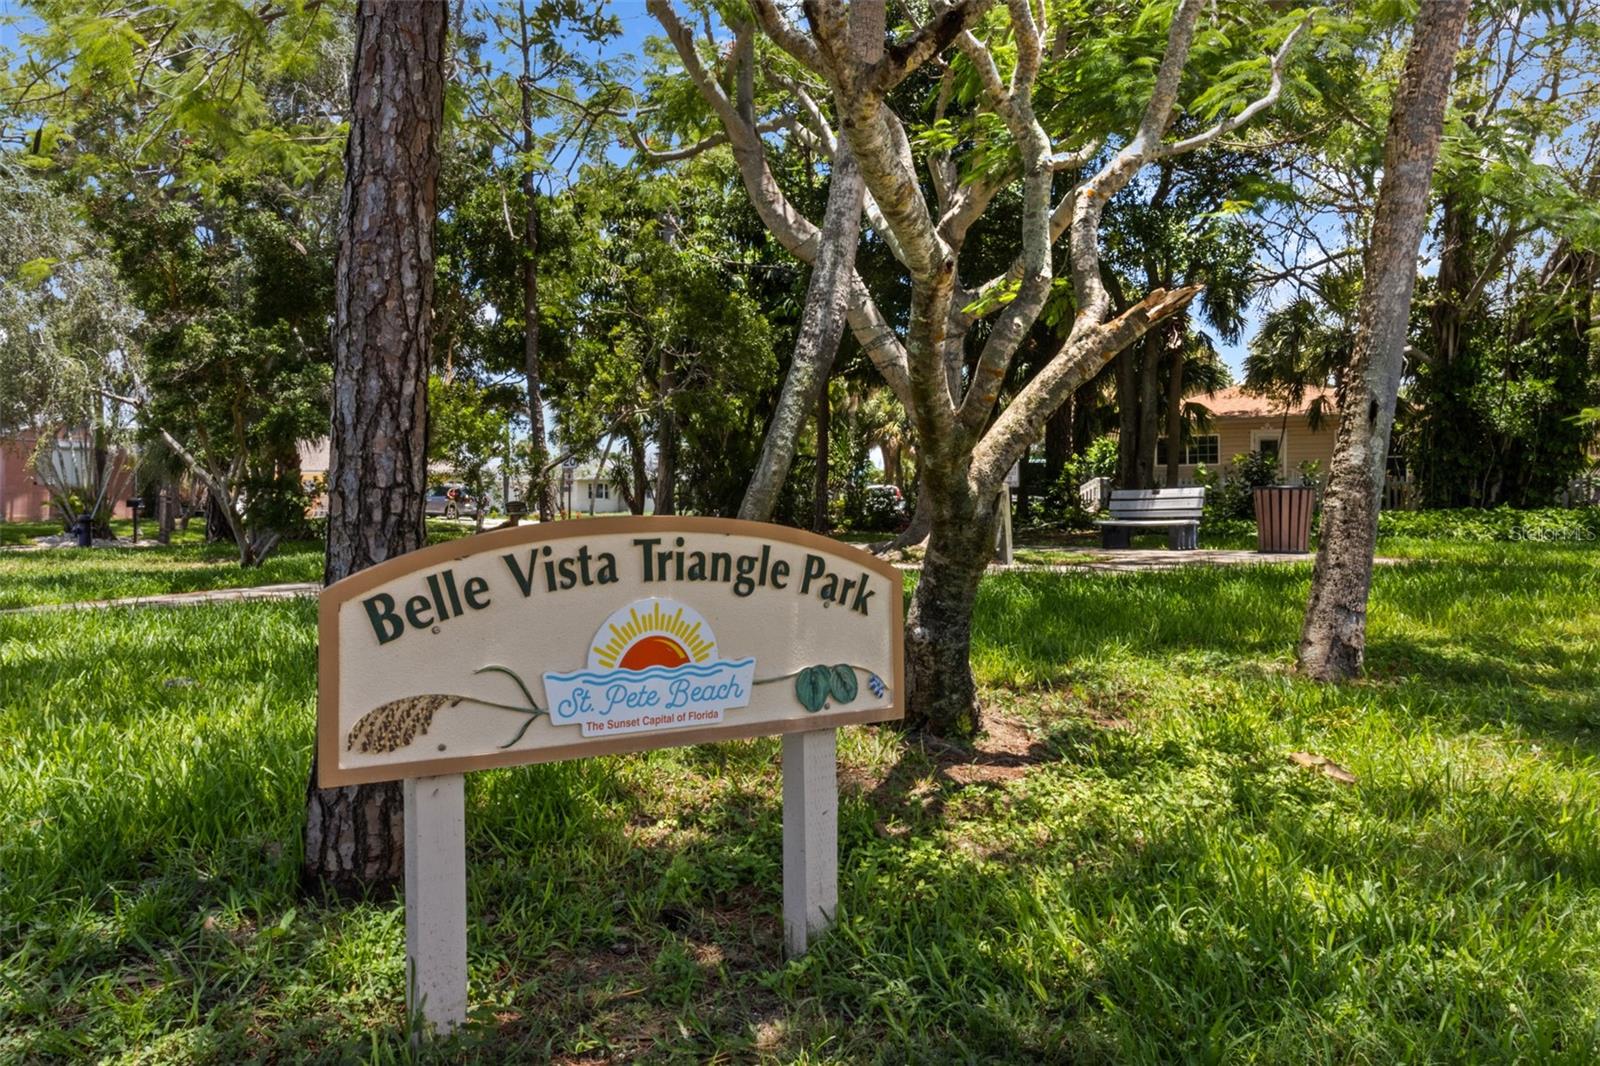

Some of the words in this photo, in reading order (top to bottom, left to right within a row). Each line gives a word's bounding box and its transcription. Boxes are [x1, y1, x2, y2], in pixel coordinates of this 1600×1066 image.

[362, 569, 491, 645] Belle
[502, 545, 619, 598] Vista
[633, 537, 790, 597] Triangle
[800, 554, 876, 616] Park
[558, 687, 594, 718] St.
[599, 683, 660, 716] Pete
[665, 674, 744, 709] Beach
[586, 722, 605, 732] The
[607, 716, 641, 730] Sunset
[642, 712, 675, 728] Capital
[677, 711, 687, 723] of
[688, 709, 719, 722] Florida
